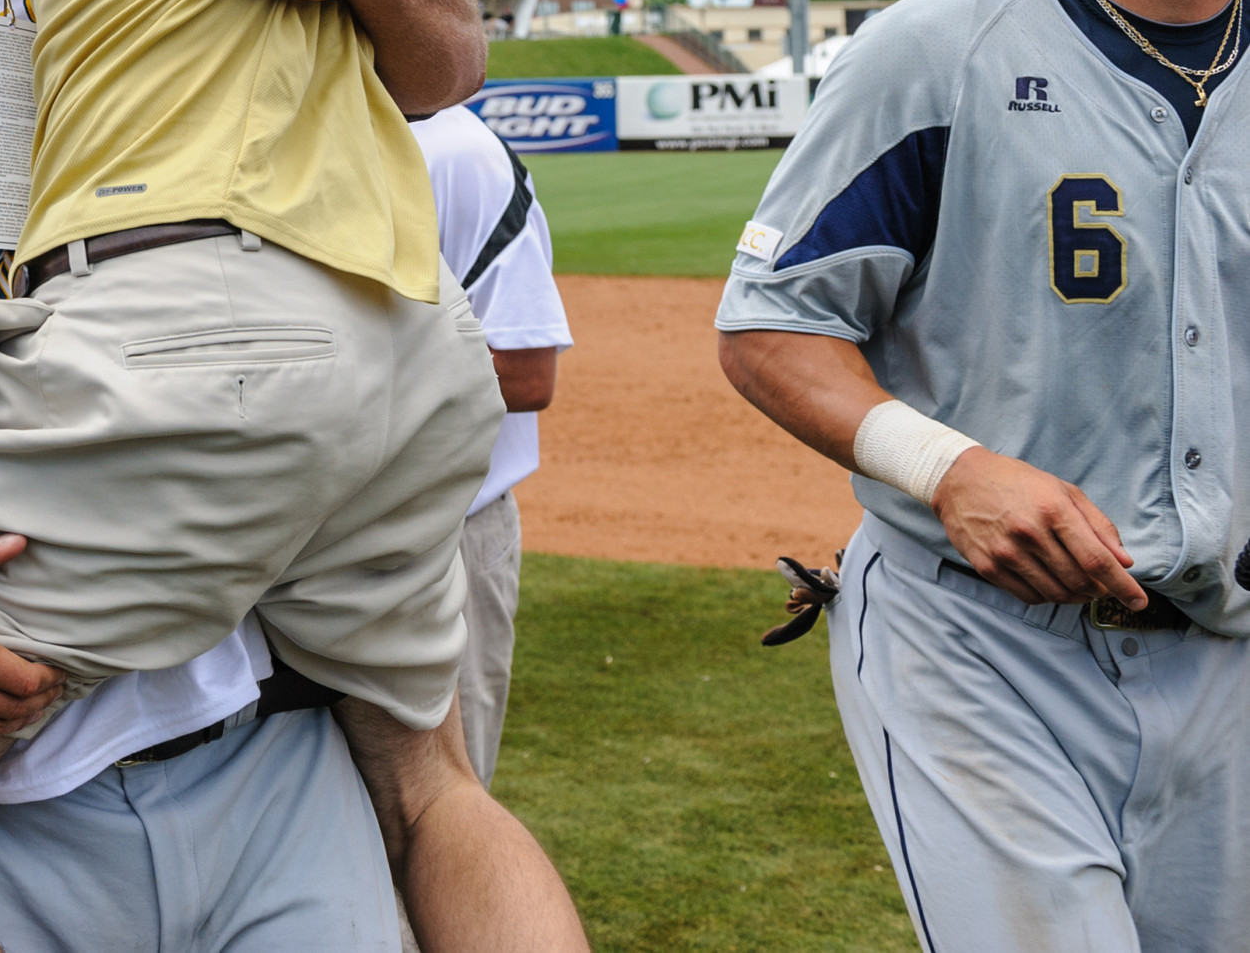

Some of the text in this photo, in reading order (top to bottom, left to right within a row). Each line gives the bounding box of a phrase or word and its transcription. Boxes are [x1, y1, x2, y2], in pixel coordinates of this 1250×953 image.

[479, 95, 587, 117] BUD
[690, 80, 778, 110] PMi
[1008, 101, 1062, 113] RUSSELL
[485, 114, 600, 138] IGHT
[1046, 173, 1128, 304] 6
